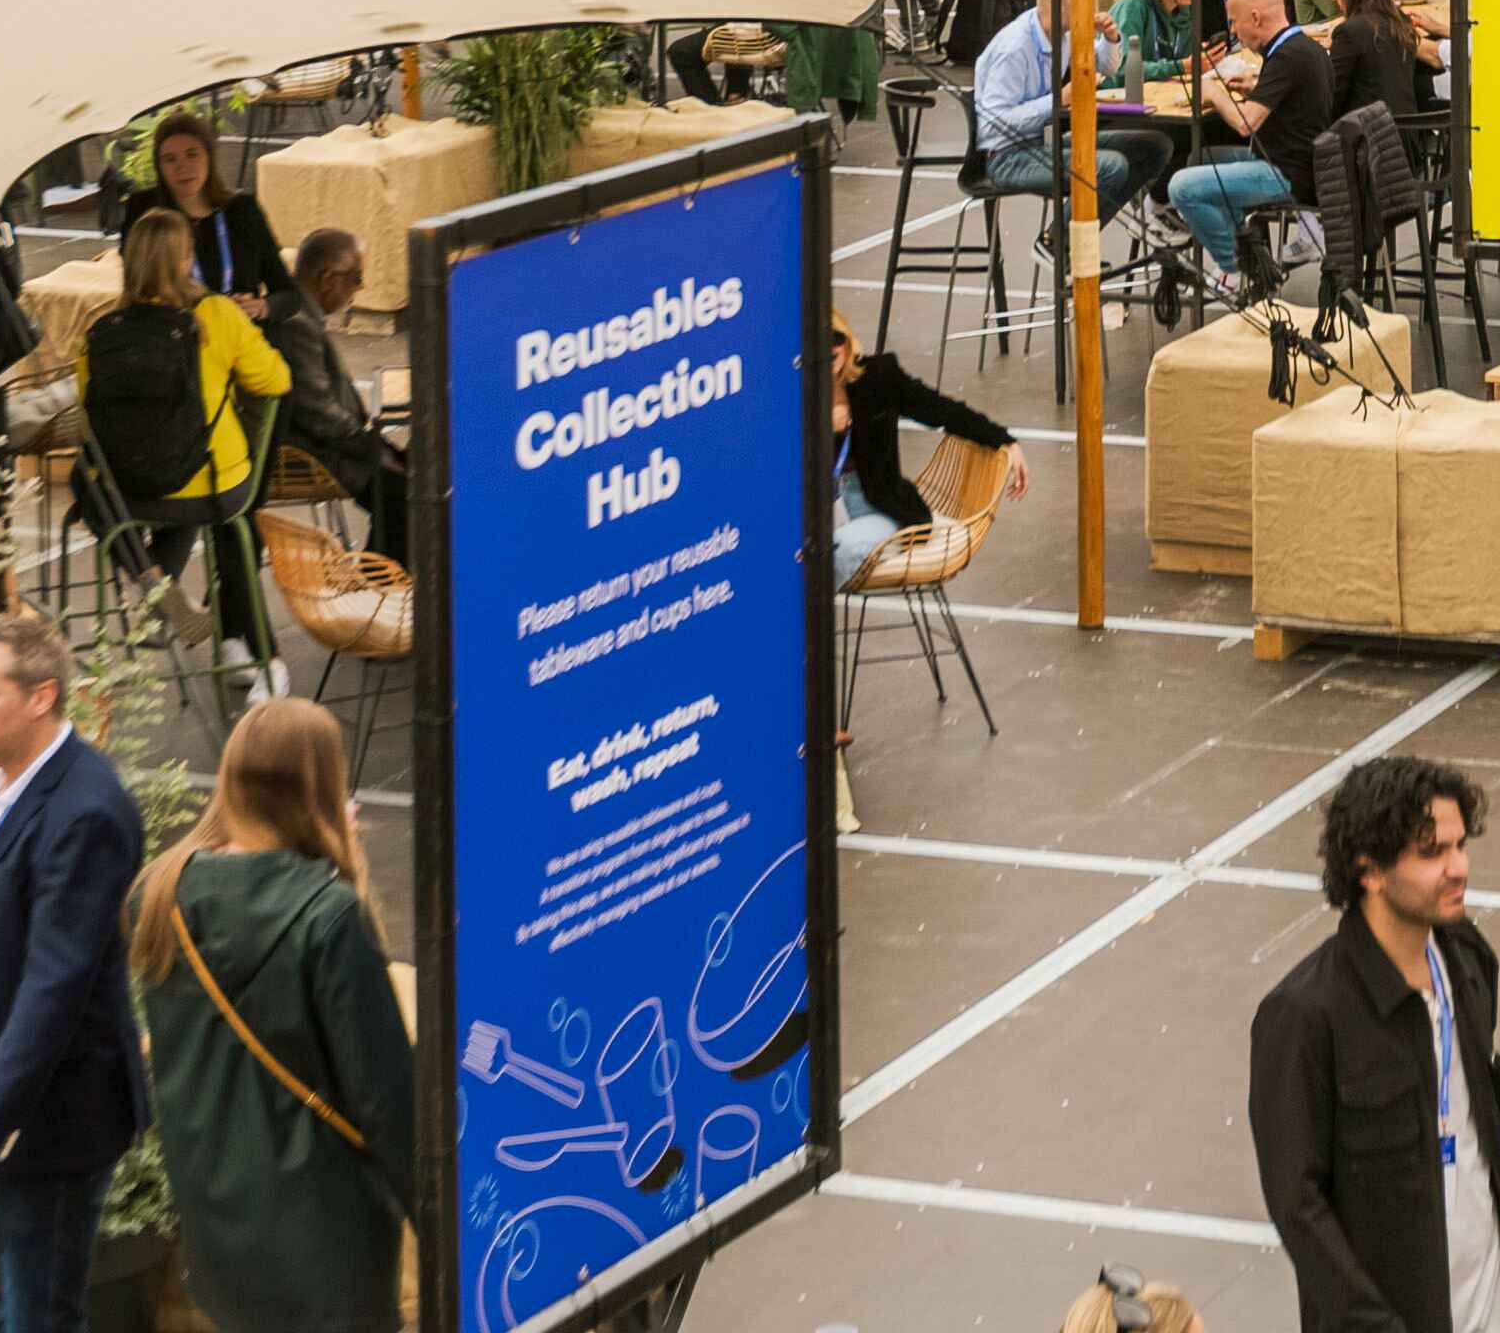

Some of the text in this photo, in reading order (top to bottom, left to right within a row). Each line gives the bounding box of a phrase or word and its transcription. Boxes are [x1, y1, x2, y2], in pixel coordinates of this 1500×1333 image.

[516, 277, 744, 391] Reusables
[514, 354, 743, 470] Collection
[587, 447, 682, 530] Hub
[517, 521, 741, 641] Please return your reusable
[528, 579, 735, 688] tableware and cups here.
[547, 692, 721, 792] Eat, drink, return,
